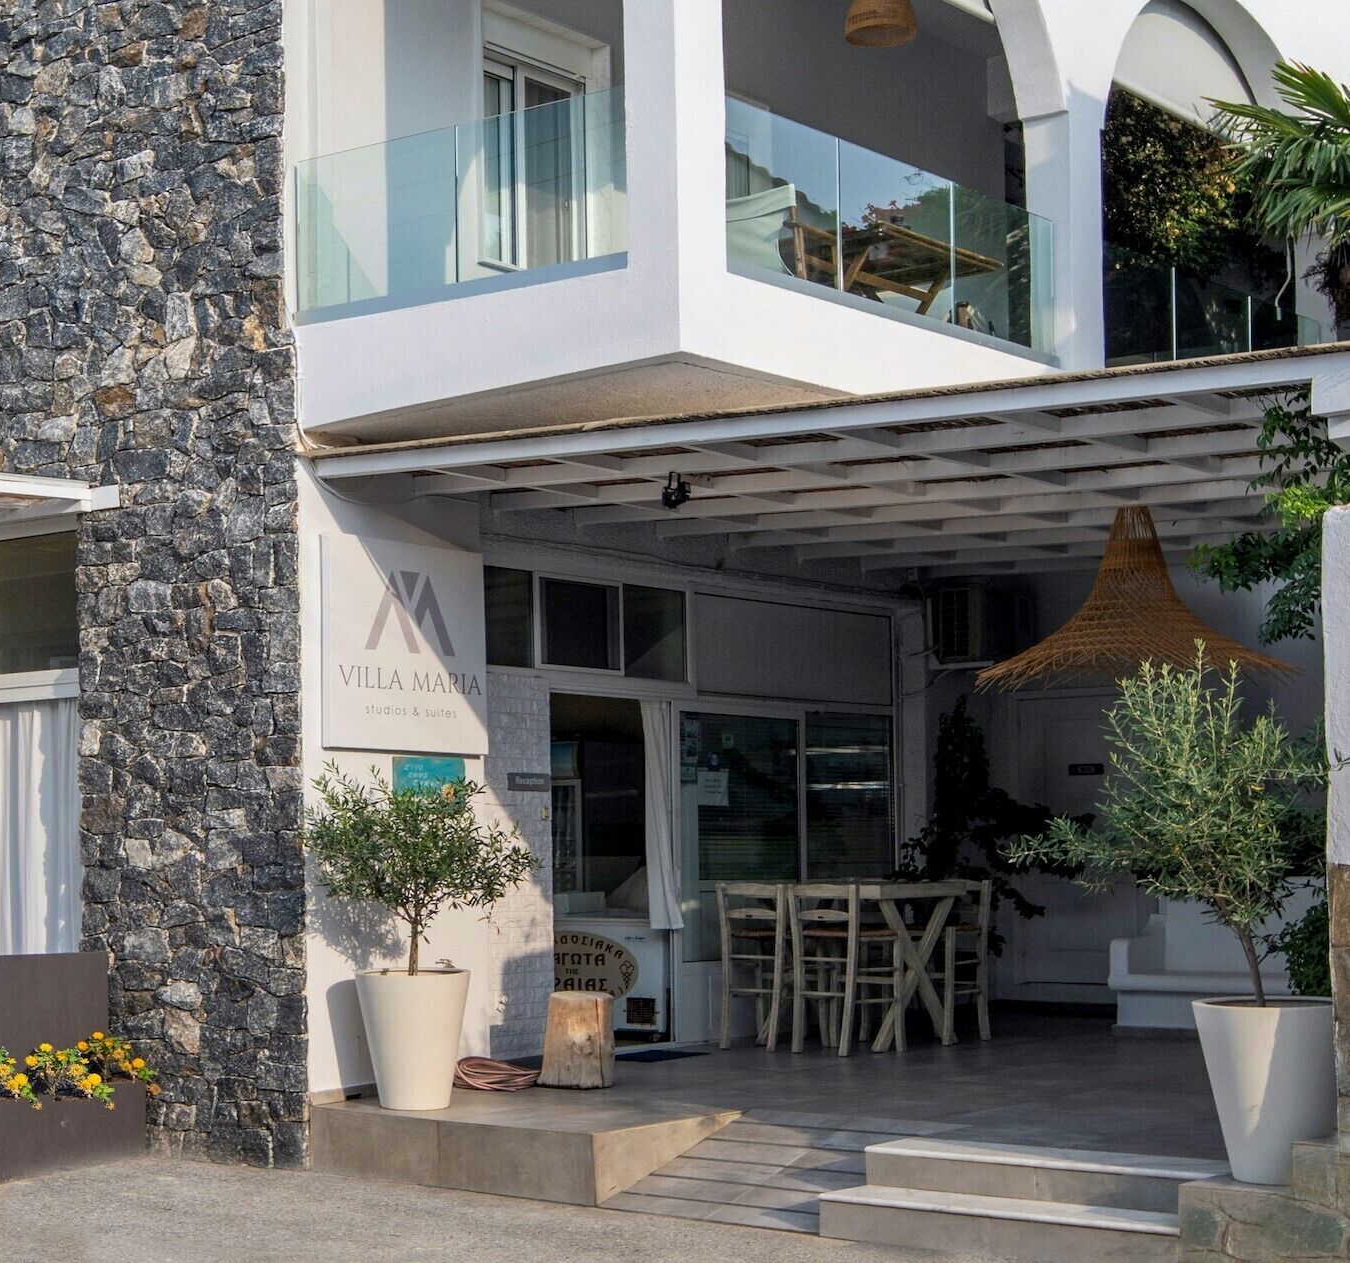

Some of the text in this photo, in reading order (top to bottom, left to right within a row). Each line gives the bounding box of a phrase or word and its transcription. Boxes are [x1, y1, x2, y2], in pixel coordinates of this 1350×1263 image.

[338, 664, 482, 696] VILLA MARIA
[365, 703, 457, 719] studios & suites
[515, 776, 545, 786] Reception
[554, 952, 606, 966] ΑΓΩΤΑ
